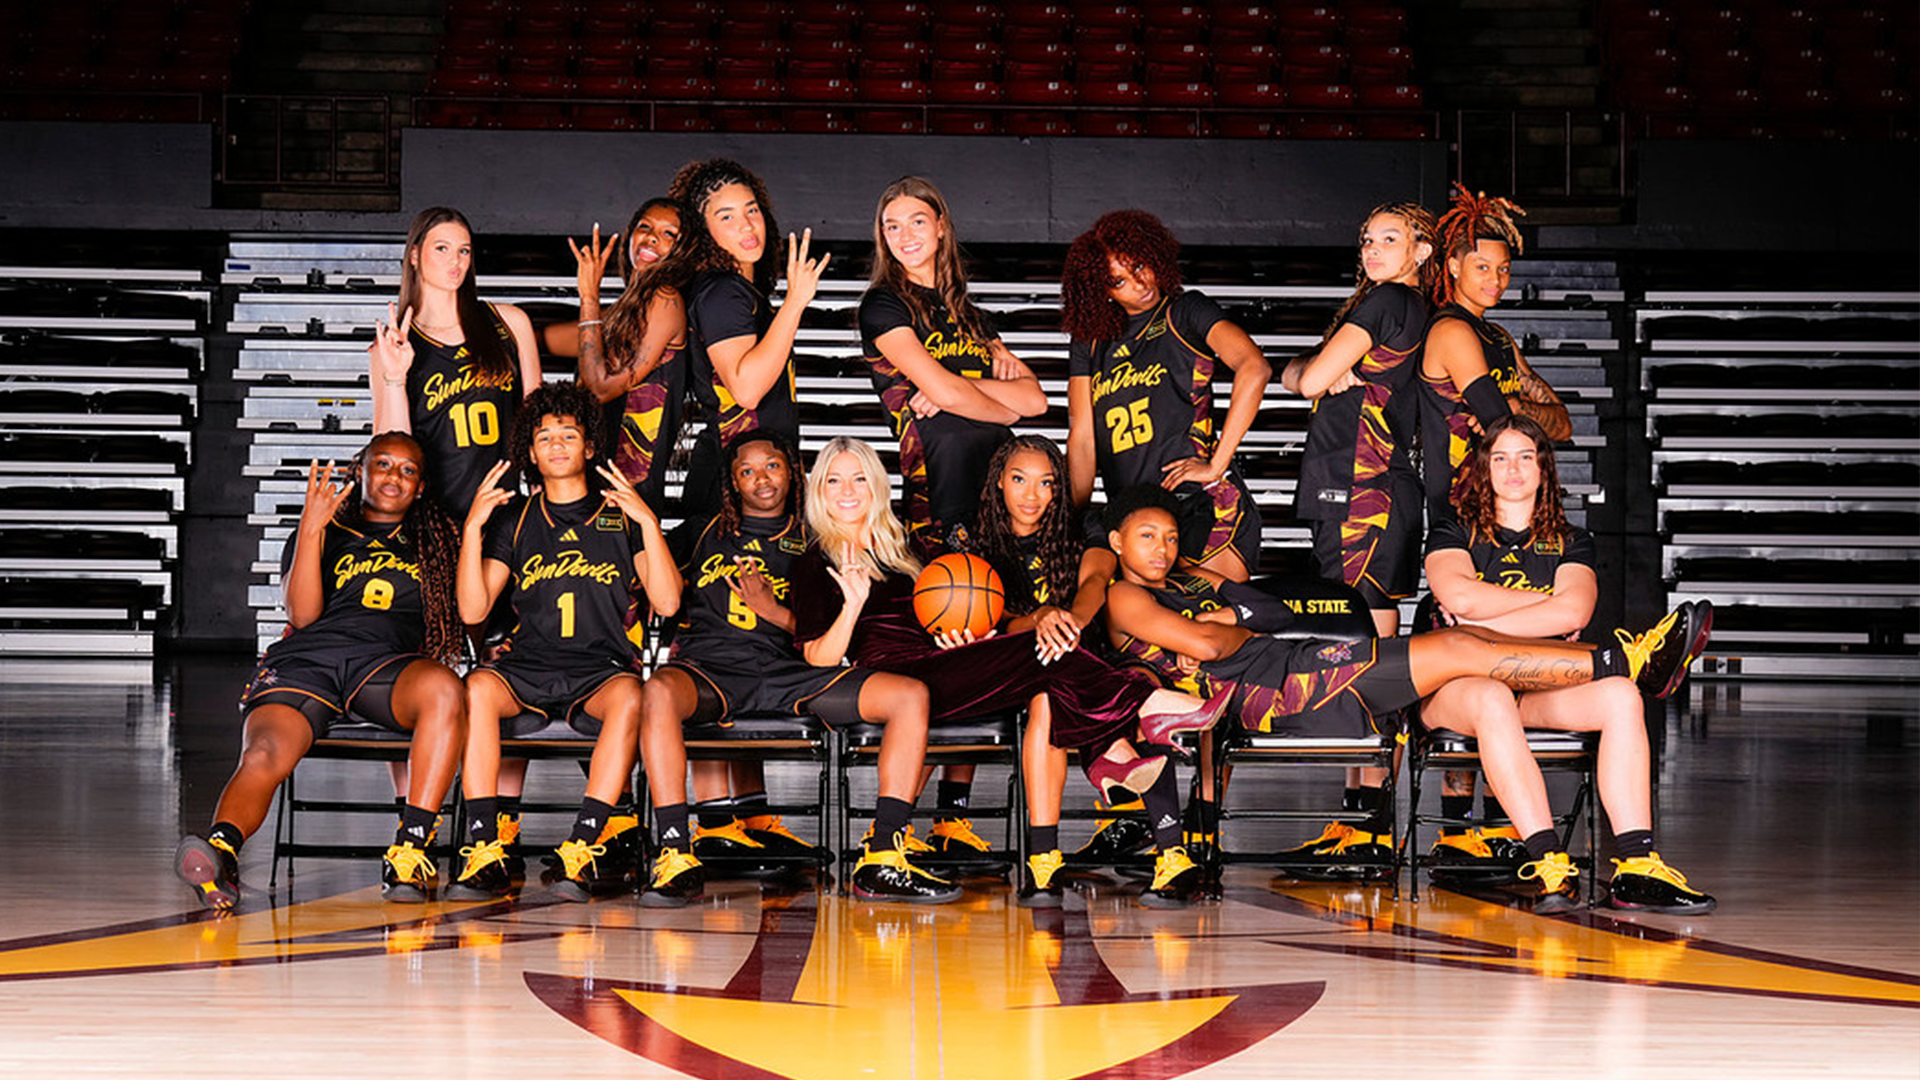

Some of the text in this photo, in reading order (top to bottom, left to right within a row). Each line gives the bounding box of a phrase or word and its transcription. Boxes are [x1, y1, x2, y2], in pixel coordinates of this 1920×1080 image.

[448, 401, 500, 447] 10
[1105, 396, 1154, 454] 25
[361, 577, 395, 610] 8
[557, 592, 575, 638] 1
[727, 590, 757, 630] 5
[1306, 599, 1352, 614] STATE
